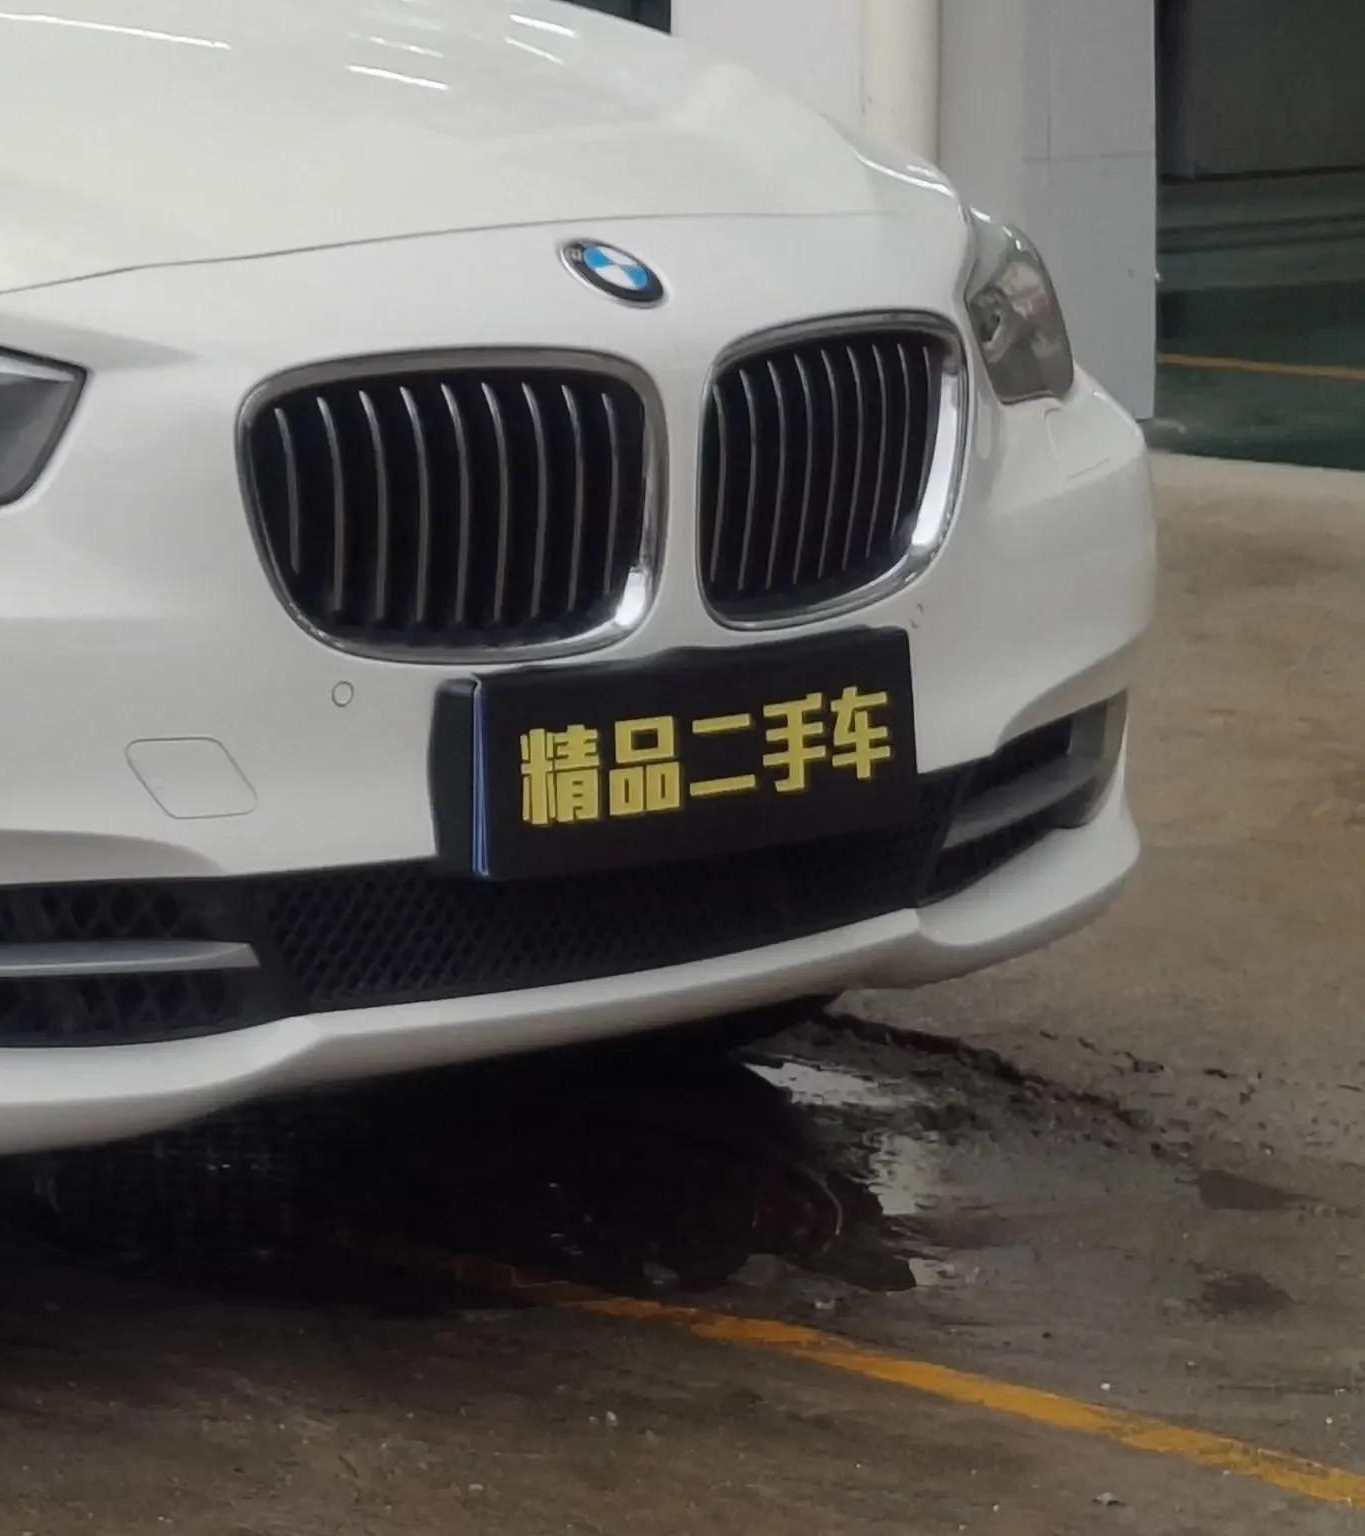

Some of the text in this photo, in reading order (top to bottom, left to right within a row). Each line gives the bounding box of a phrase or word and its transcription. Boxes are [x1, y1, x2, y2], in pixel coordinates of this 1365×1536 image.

[519, 686, 891, 826] 精品二手车
